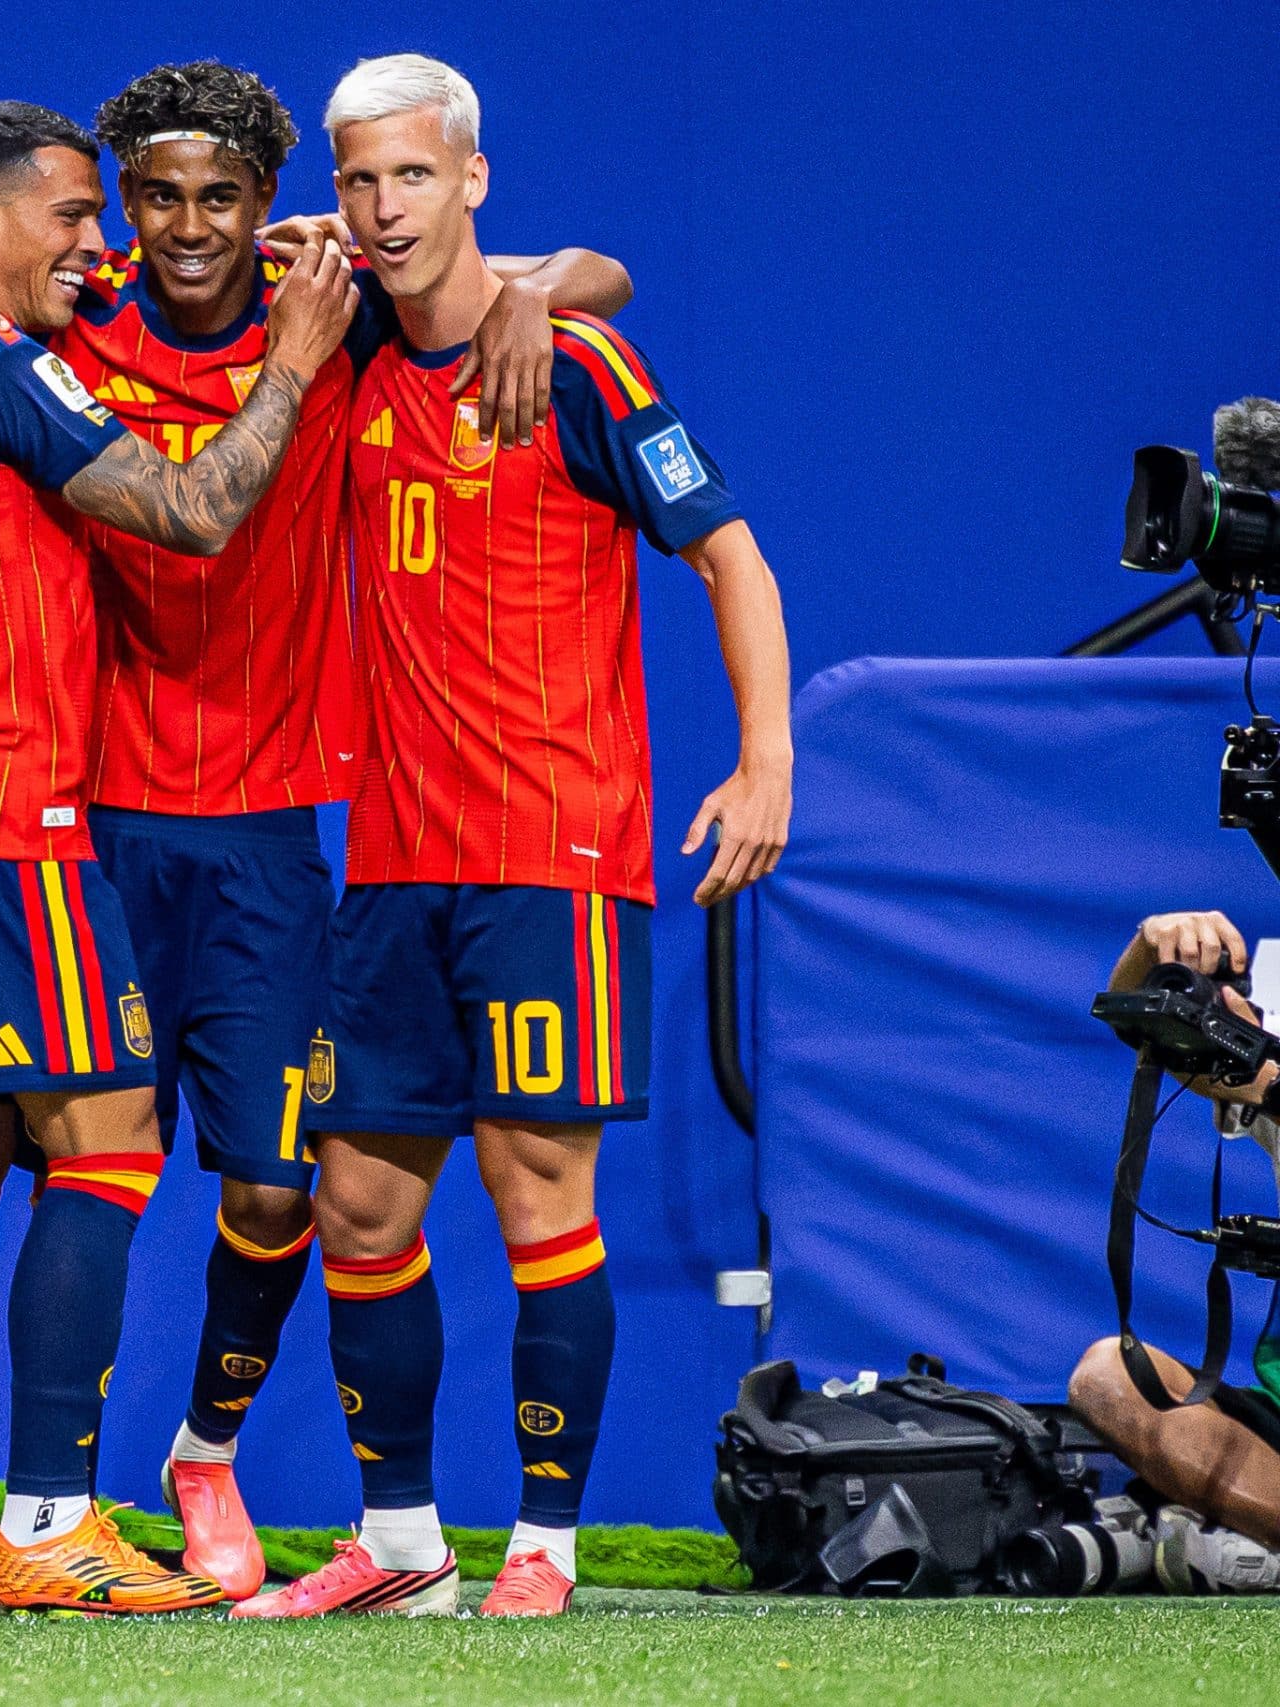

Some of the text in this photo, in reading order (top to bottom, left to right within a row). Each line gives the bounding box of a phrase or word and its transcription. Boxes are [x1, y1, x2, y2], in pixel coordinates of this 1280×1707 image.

[388, 480, 436, 574] 10
[488, 1000, 563, 1093] 10
[279, 1066, 317, 1163] 1
